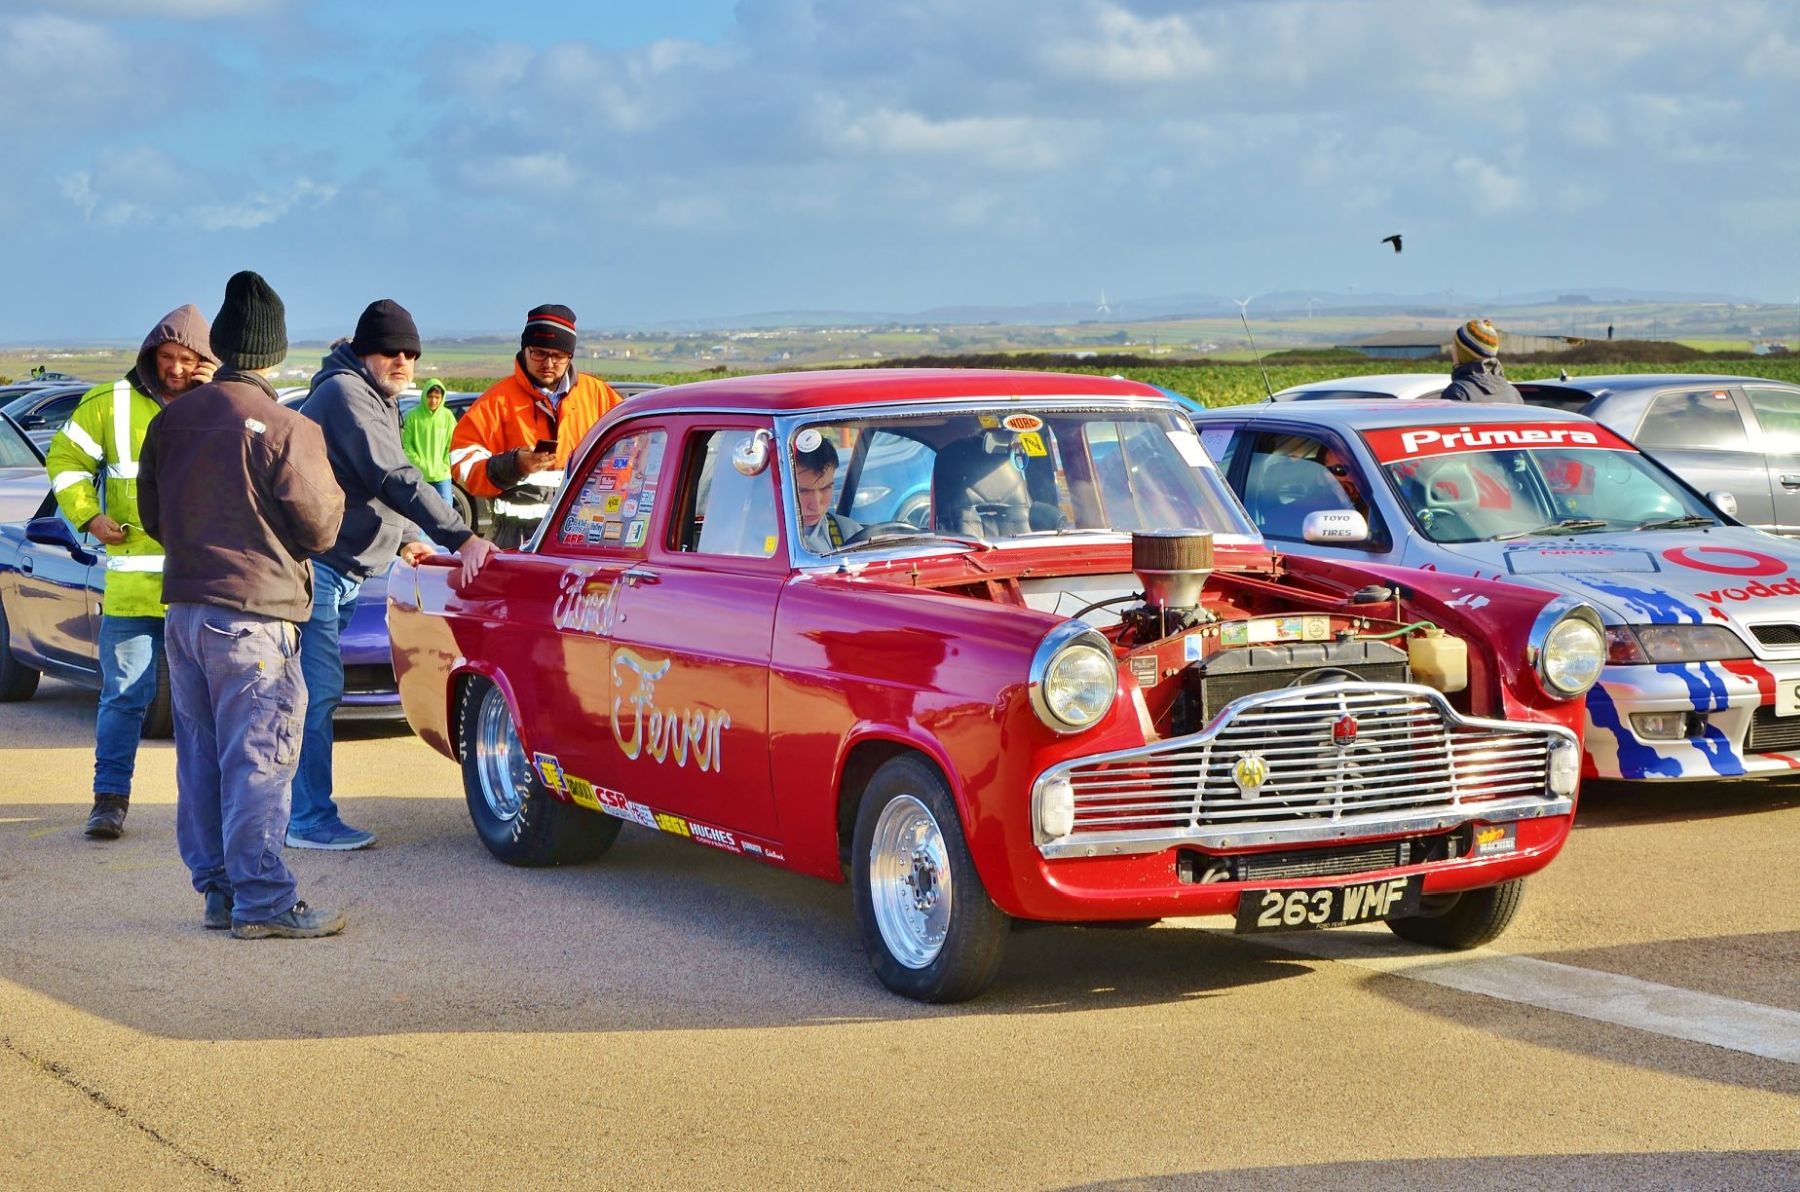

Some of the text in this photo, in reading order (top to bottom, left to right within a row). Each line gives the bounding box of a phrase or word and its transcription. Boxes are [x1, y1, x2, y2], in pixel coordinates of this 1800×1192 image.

[1401, 427, 1598, 453] Primera
[1322, 529, 1352, 537] TIRES
[611, 647, 731, 773] Fever
[595, 788, 628, 811] CSR
[688, 822, 735, 846] HUGHES
[1257, 879, 1408, 927] 263 WMF
